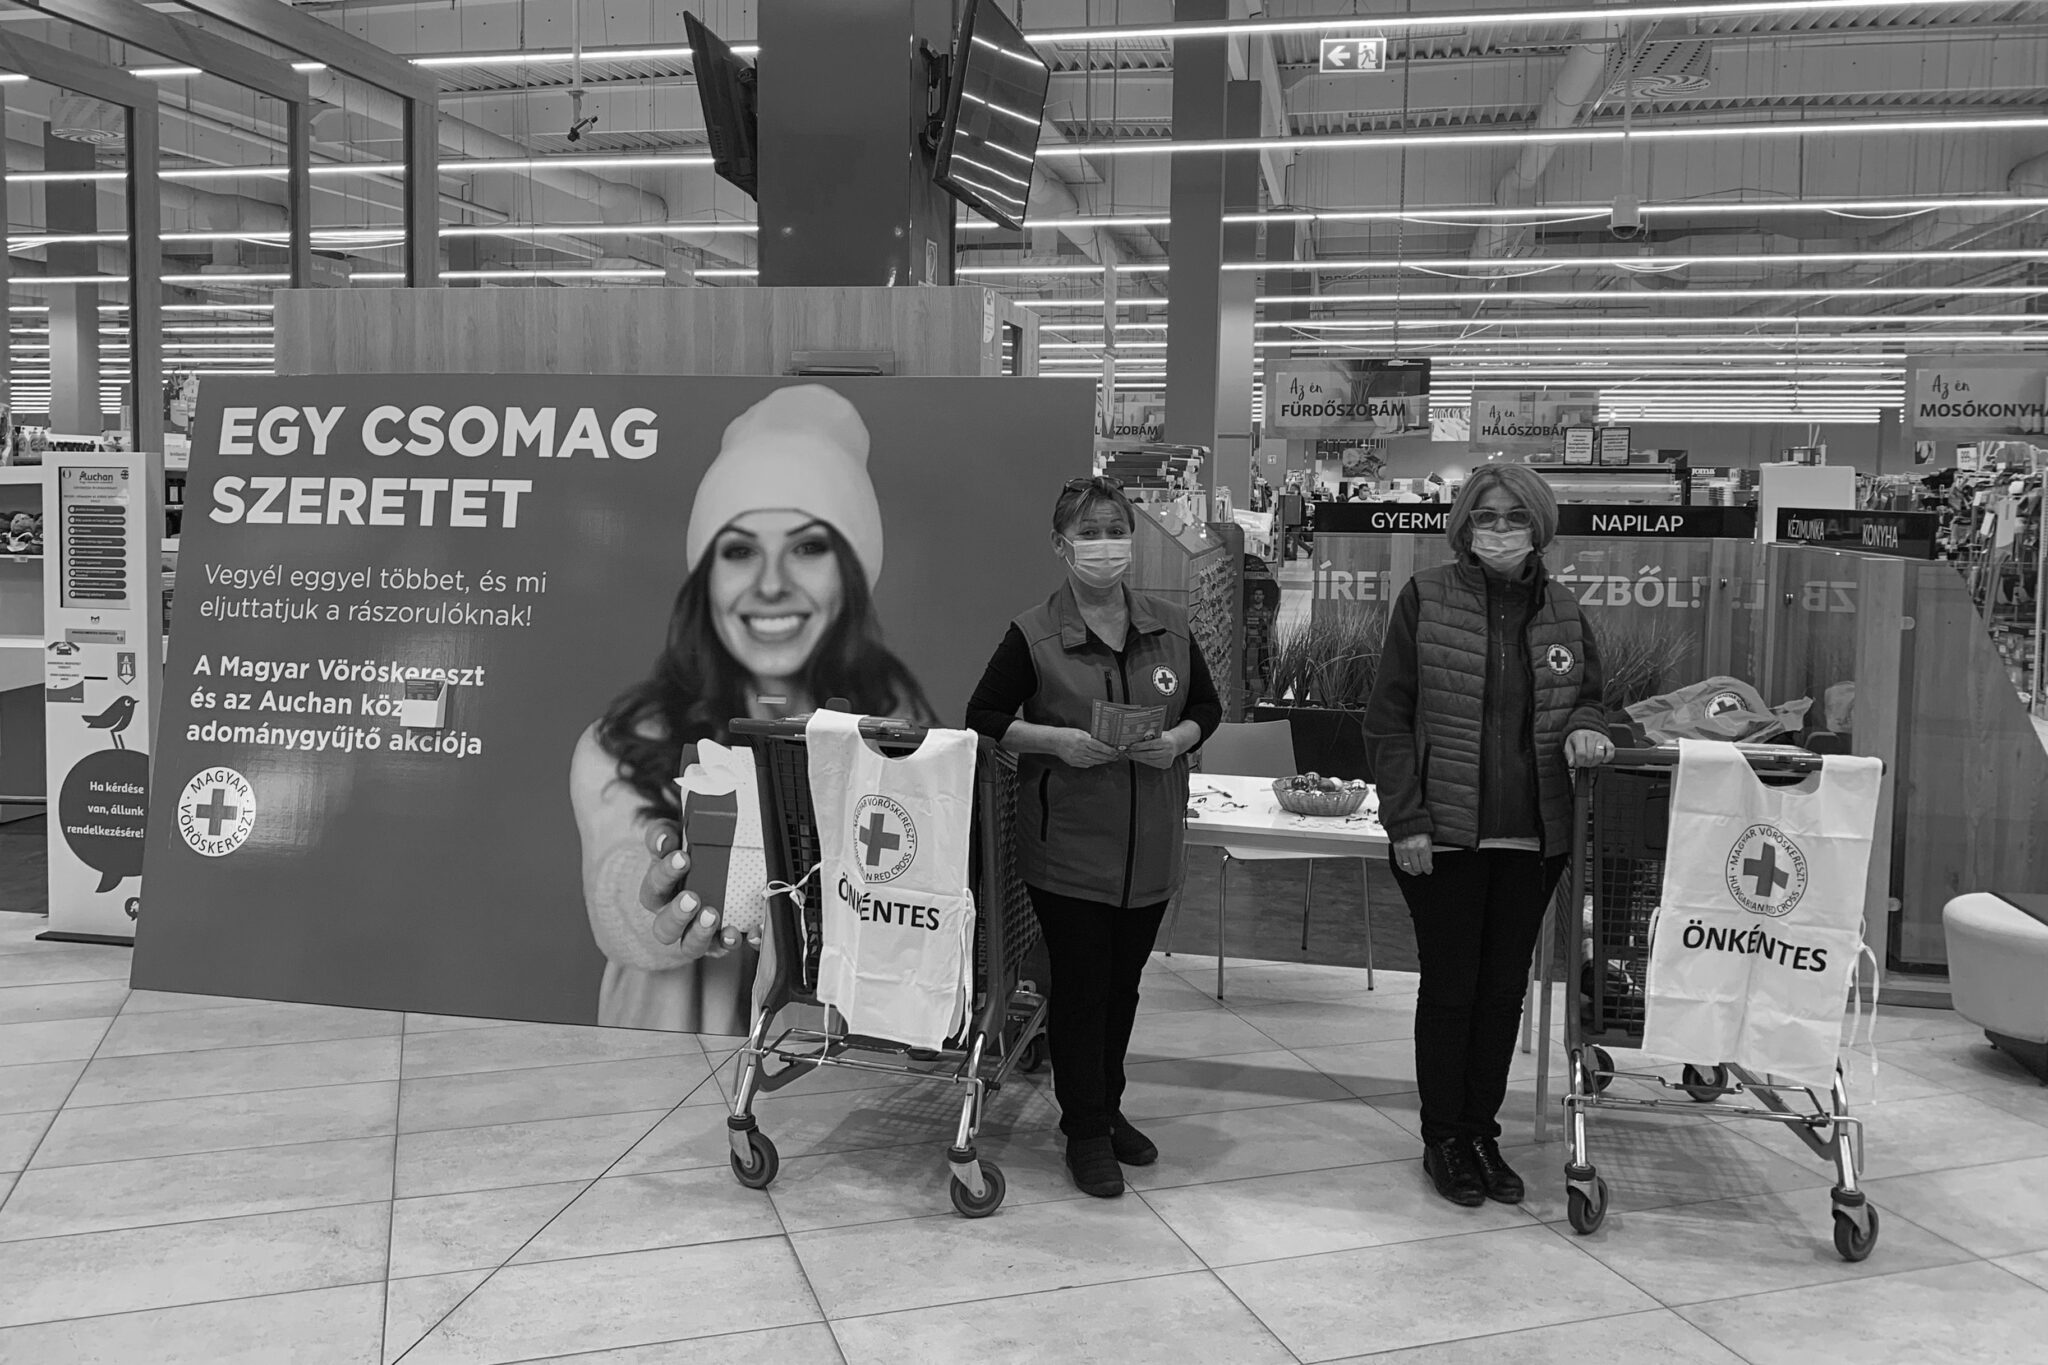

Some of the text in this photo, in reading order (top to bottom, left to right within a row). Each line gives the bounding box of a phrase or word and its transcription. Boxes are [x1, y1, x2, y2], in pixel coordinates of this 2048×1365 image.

[1290, 377, 1304, 401] Az
[1932, 374, 1949, 400] Az
[1281, 400, 1406, 417] FÜRDŐSZOBÁM
[1489, 405, 1501, 423] Az
[219, 406, 658, 460] EGY CSOMAG
[79, 471, 113, 481] Auchan
[209, 476, 532, 529] SZERETET
[1592, 514, 1683, 532] NAPILAP
[1787, 514, 1825, 541] KÉZIMUNKA
[1862, 523, 1899, 549] KONYHA
[205, 564, 547, 594] Vegyél eggyel többet, és mi
[200, 596, 532, 627] eljuttatjuk a rászorulóknak!
[194, 655, 485, 687] A Magyar Vöröskereszt
[190, 686, 216, 709] és
[224, 693, 251, 710] az
[258, 691, 353, 715] Auchan
[186, 721, 482, 758] adománygyűjtő akciója
[89, 781, 144, 794] Ha kérdése
[190, 770, 248, 797] MAGYAR
[87, 804, 144, 816] van, állunk
[867, 797, 915, 845] VÖRÖSKERESZT
[67, 825, 144, 839] rendelkezésére!
[179, 803, 255, 855] VÖRÖSKERESZT
[874, 871, 891, 881] RED
[890, 852, 912, 876] CROSS
[1730, 827, 1805, 883] MAGYAR VÖRÖSKERESZT
[838, 870, 940, 931] ÖNKÉNTES
[1728, 875, 1765, 911] HUNGARIAN
[1777, 890, 1800, 913] CROSS
[1682, 919, 1828, 972] ÖNKÉNTES
